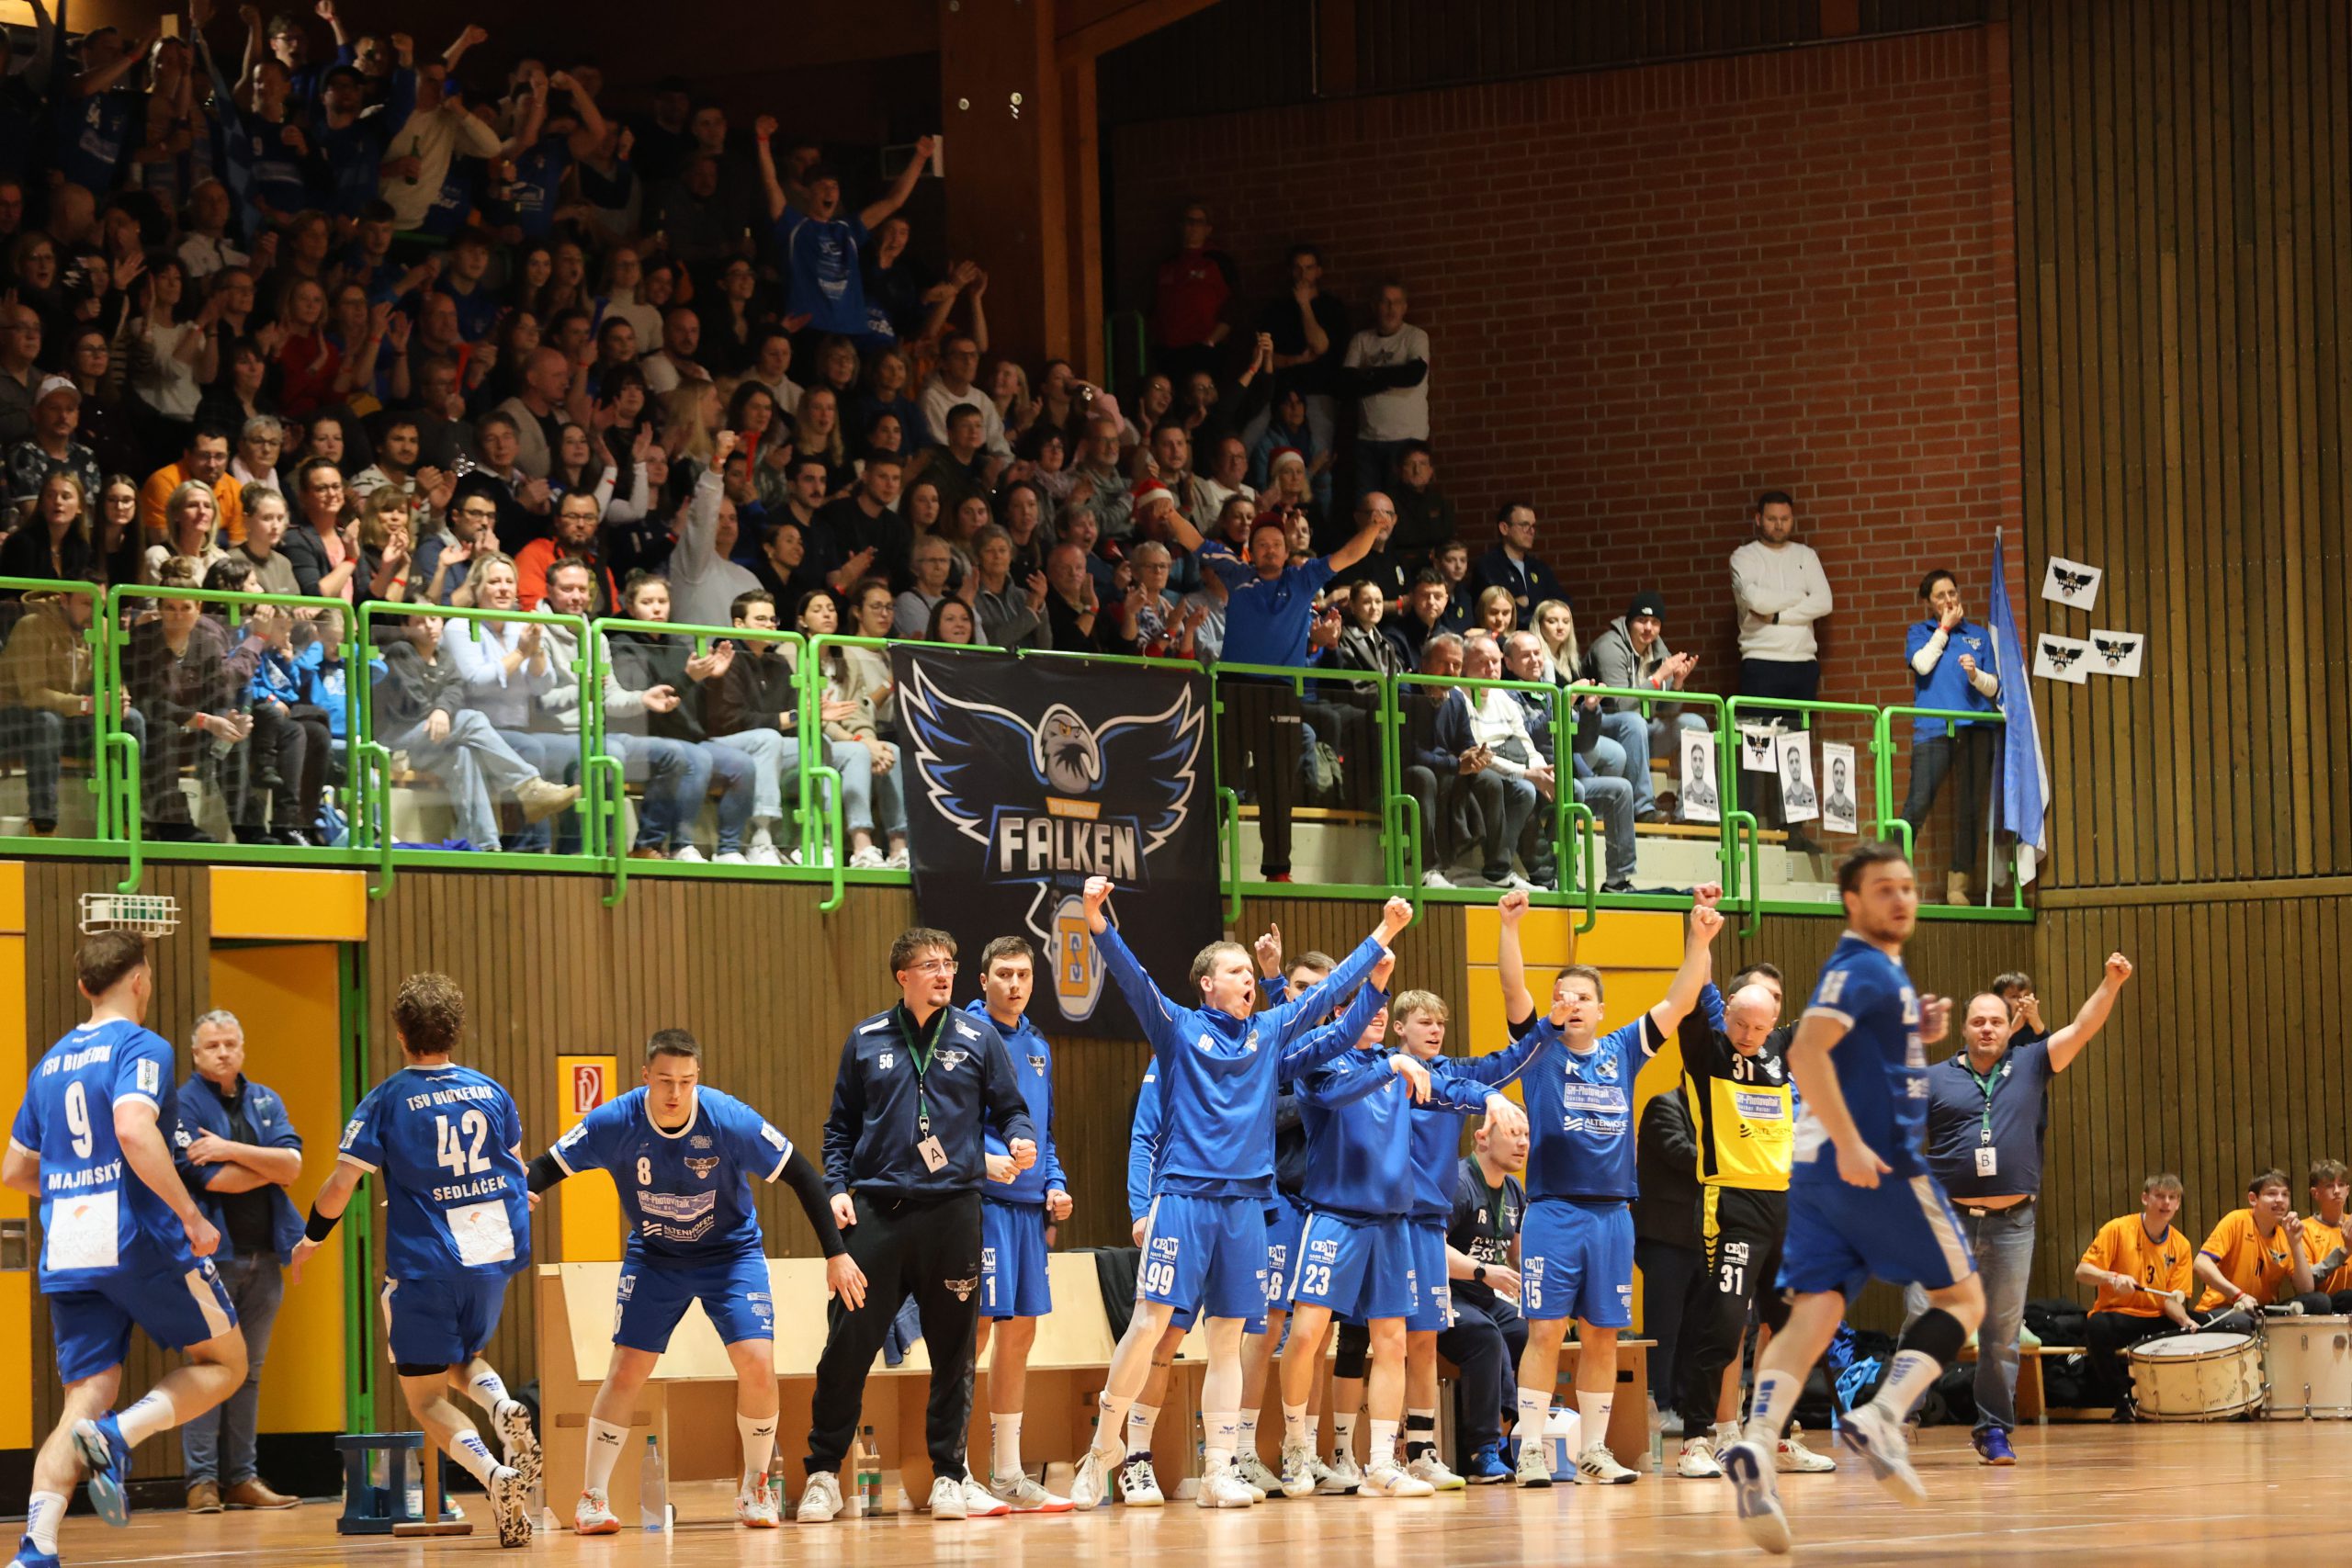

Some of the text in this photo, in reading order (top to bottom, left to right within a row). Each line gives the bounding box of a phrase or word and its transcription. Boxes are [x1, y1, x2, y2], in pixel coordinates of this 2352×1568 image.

[1000, 817, 1136, 881] FALKEN
[1197, 1033, 1215, 1052] 99
[41, 1055, 62, 1078] TSV
[878, 1053, 894, 1070] 56
[1732, 1053, 1755, 1082] 31
[406, 1093, 432, 1111] TSV
[64, 1080, 93, 1160] 9
[435, 1109, 492, 1178] 42
[931, 1147, 943, 1164] A
[636, 1156, 652, 1186] 8
[1981, 1154, 1990, 1168] B
[432, 1175, 509, 1202] SEDLÁČEK
[1145, 1261, 1175, 1296] 99
[1267, 1270, 1283, 1302] 8
[1302, 1263, 1331, 1296] 23
[1719, 1264, 1743, 1296] 31
[2145, 1264, 2155, 1284] 3
[1523, 1280, 1543, 1310] 15
[613, 1303, 624, 1335] 8
